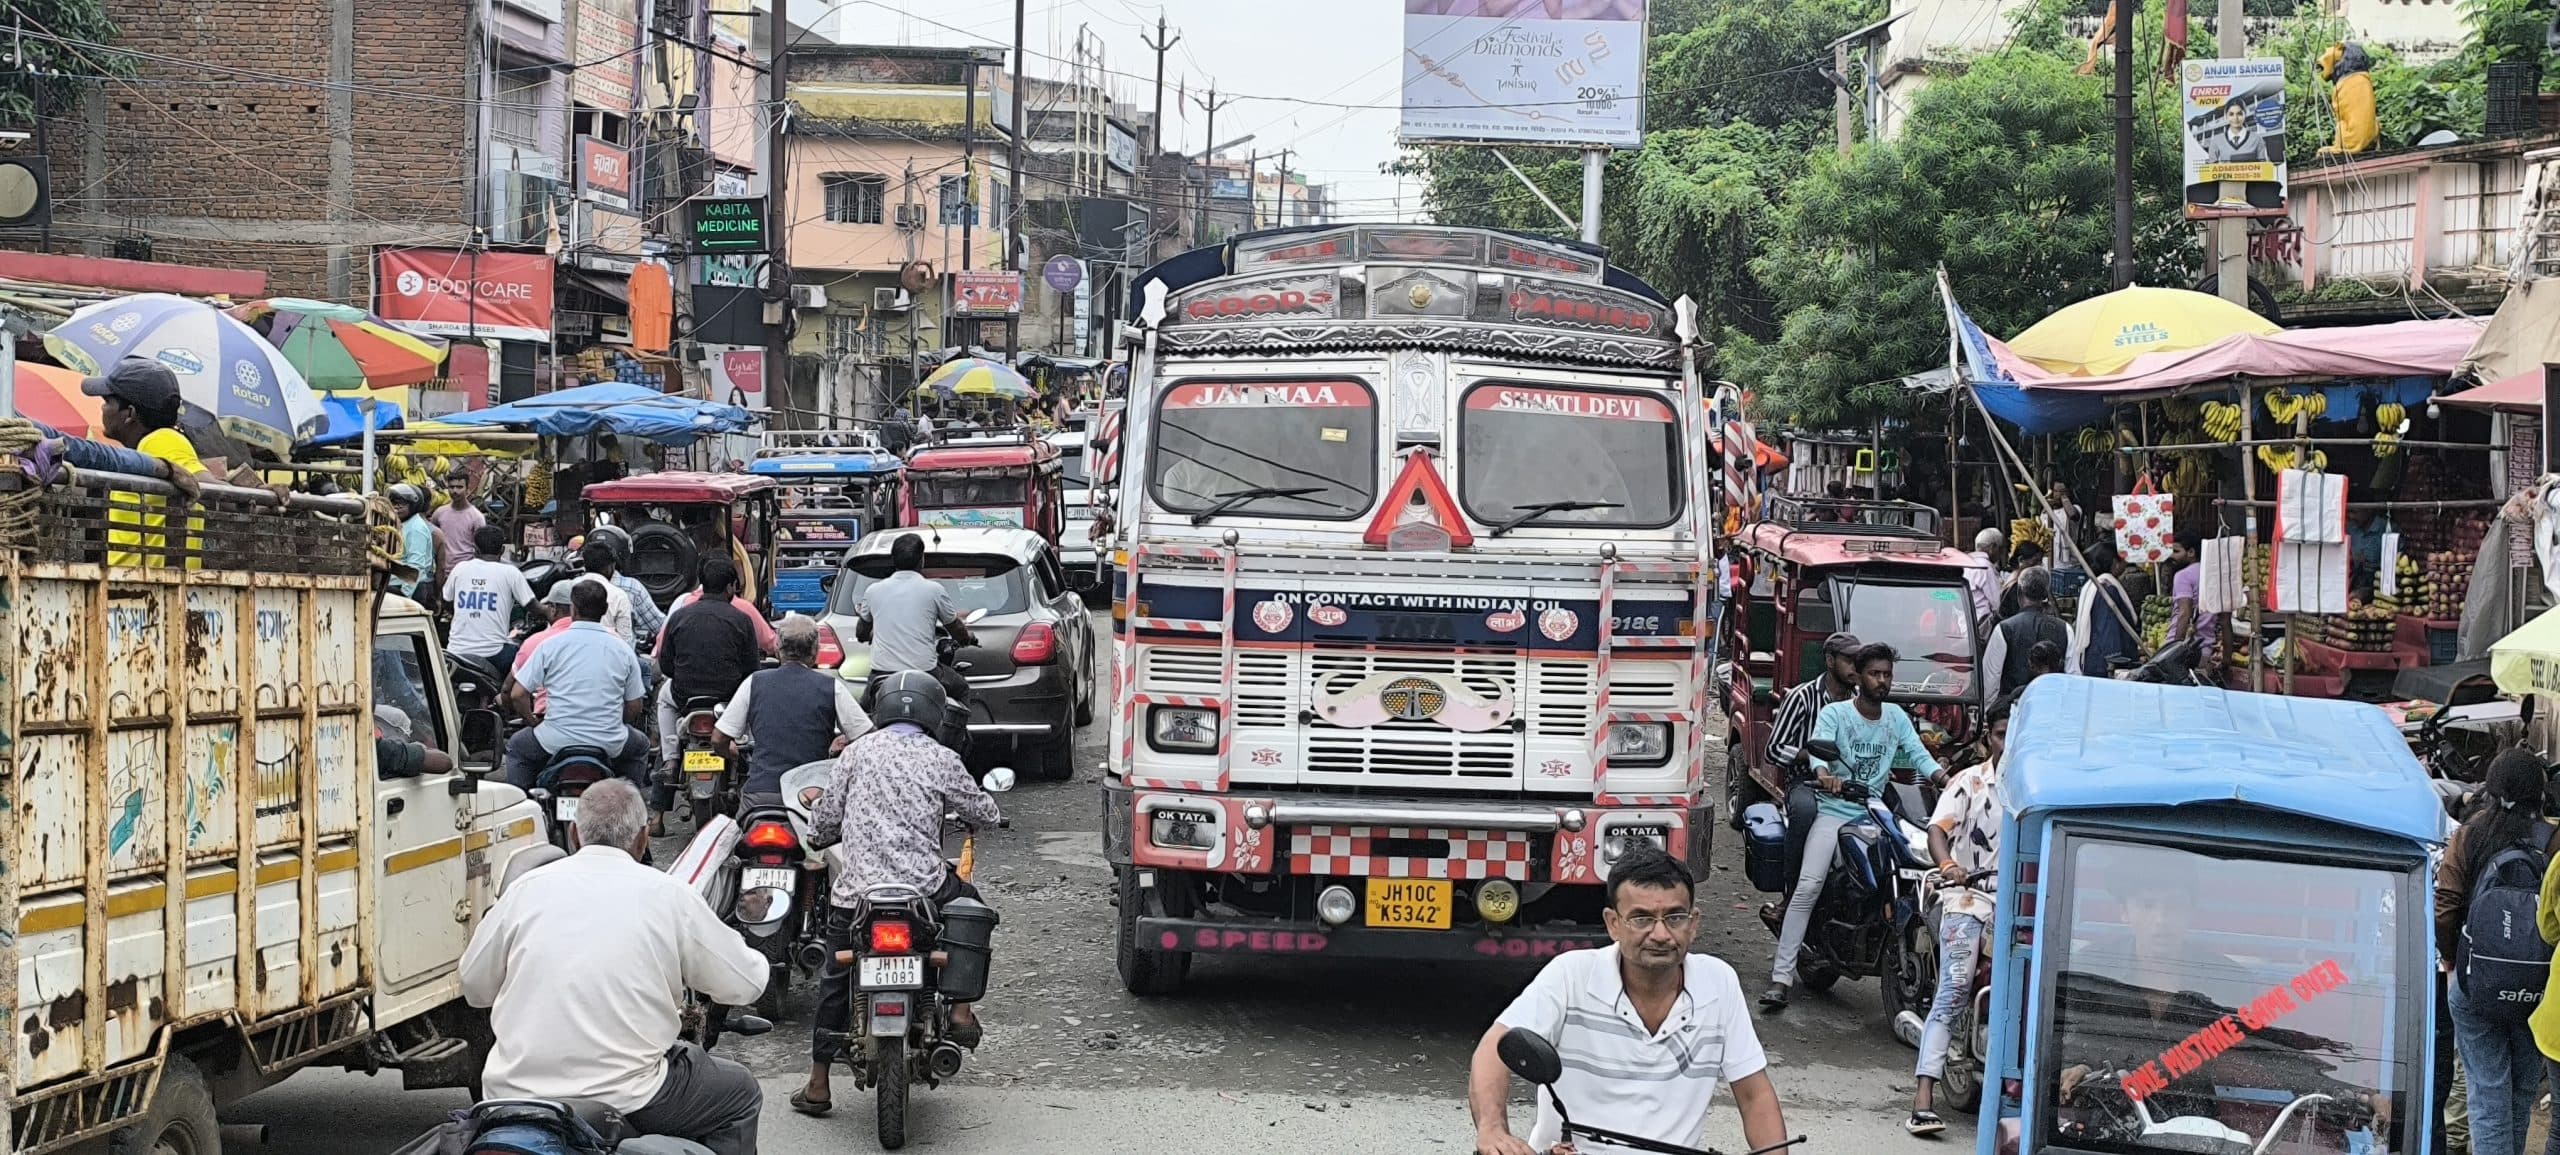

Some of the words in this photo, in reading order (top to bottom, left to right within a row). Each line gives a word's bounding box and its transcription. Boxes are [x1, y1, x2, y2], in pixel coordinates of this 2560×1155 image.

[1499, 26, 1554, 44] Festival
[1473, 39, 1564, 57] Diamonds
[2204, 65, 2237, 75] ANJUM
[2240, 64, 2282, 74] SANSKAR
[1496, 77, 1537, 93] TANISHQ
[1577, 87, 1612, 100] 20%
[2192, 86, 2229, 96] ENROLL
[2200, 97, 2220, 105] NOW
[2212, 164, 2260, 172] ADMISSION
[705, 203, 752, 216] KABITA
[697, 219, 760, 232] MEDICINE
[427, 277, 533, 299] BODYCARE
[90, 321, 121, 347] Rotary
[428, 323, 460, 332] SHARDA
[462, 325, 496, 333] DESSES
[231, 384, 271, 407] Rotary
[1264, 386, 1338, 406] MAA
[1499, 390, 1581, 414] SHAKTI
[1589, 397, 1642, 417] DEVI
[457, 590, 498, 612] SAFE
[1273, 592, 1302, 604] ON
[1305, 592, 1400, 606] CONTACT
[1401, 595, 1452, 609] WITH
[1456, 597, 1528, 611] INDIAN
[1158, 811, 1175, 820] OK
[1178, 812, 1208, 822] TATA
[1611, 827, 1629, 836] OK
[1630, 827, 1659, 836] TATA
[1381, 884, 1437, 902] JH10C
[1380, 904, 1437, 923] K5342
[2502, 908, 2512, 940] safari
[1195, 928, 1328, 950] SPEED
[876, 957, 915, 971] JH11A
[875, 971, 914, 985] G1083
[2121, 1060, 2169, 1102] ONE
[2158, 1015, 2246, 1080] MISTAKE
[2237, 985, 2297, 1031] GAME
[2290, 959, 2351, 1003] OVER
